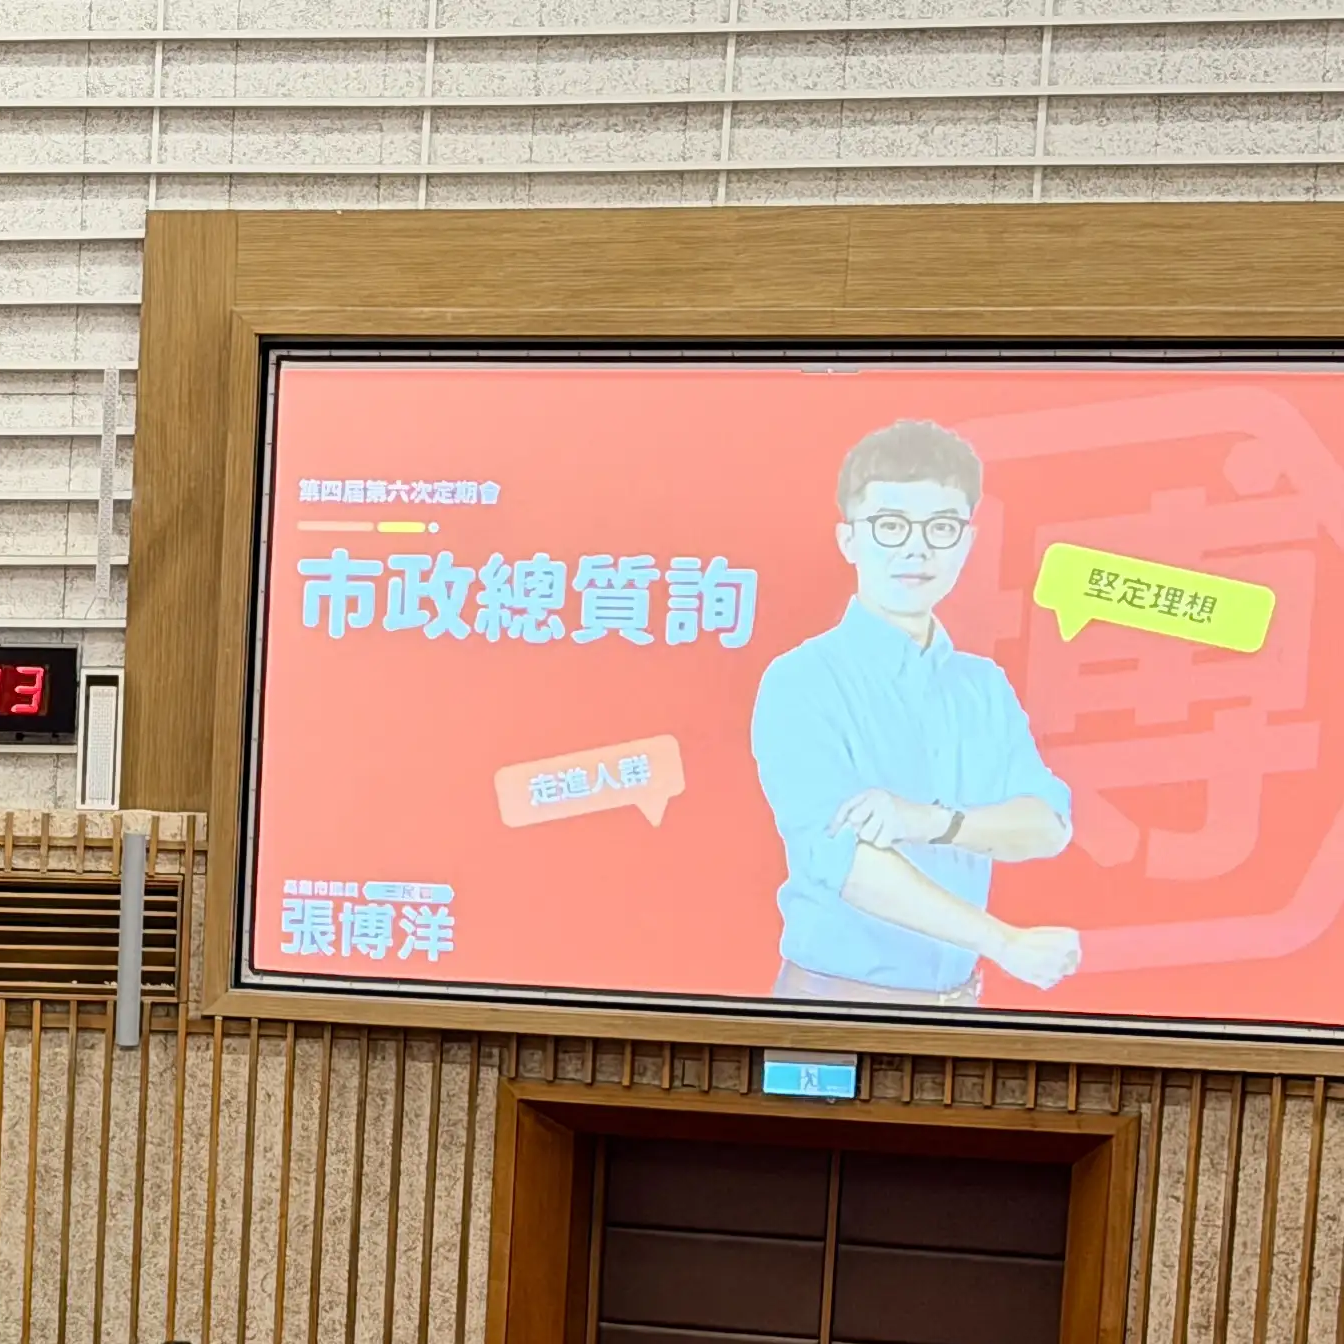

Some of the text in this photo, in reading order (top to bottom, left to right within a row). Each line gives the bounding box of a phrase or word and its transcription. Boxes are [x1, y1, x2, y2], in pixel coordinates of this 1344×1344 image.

[298, 479, 502, 505] 第四屆第六次定期會
[296, 547, 759, 649] 市政總質詢
[1083, 567, 1218, 624] 堅定理想
[527, 754, 651, 806] 走進人群
[280, 898, 455, 962] 張博洋
